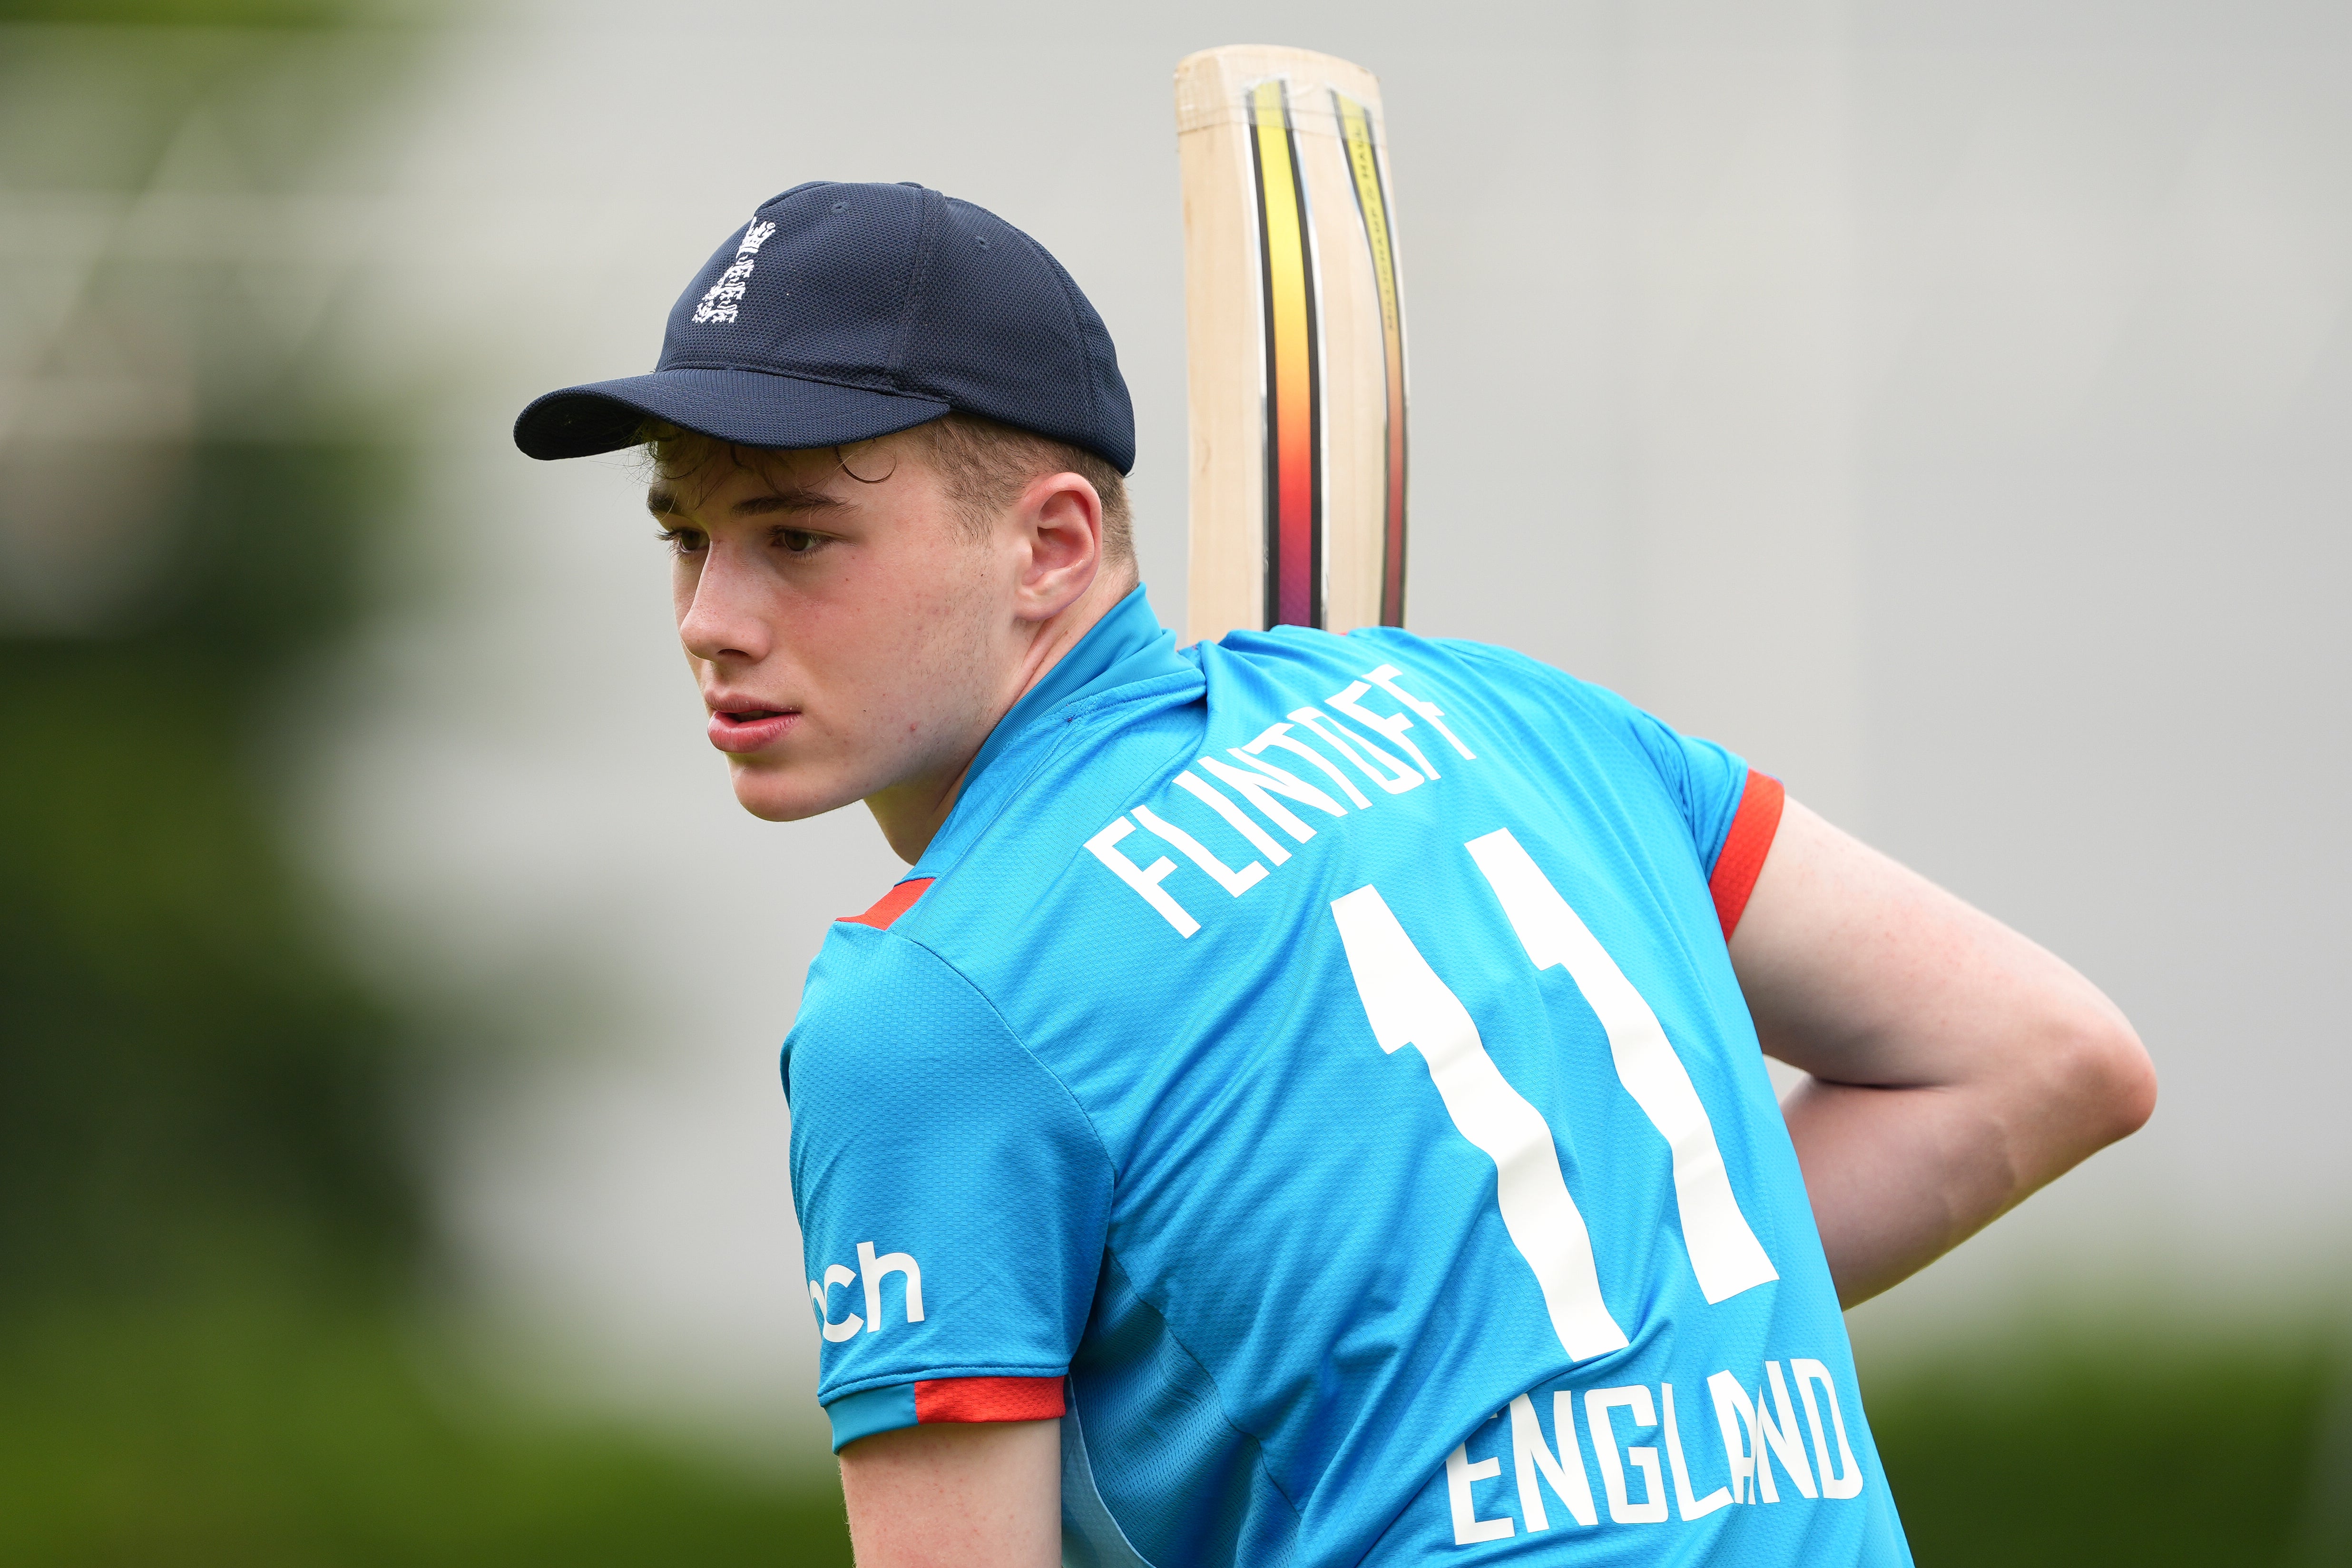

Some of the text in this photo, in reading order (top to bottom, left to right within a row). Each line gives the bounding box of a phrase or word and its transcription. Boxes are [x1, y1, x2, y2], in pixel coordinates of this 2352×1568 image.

[1083, 663, 1477, 940] FLINTOFF
[1330, 827, 1780, 1362] 11
[1446, 1358, 1863, 1546] ENGLAND
